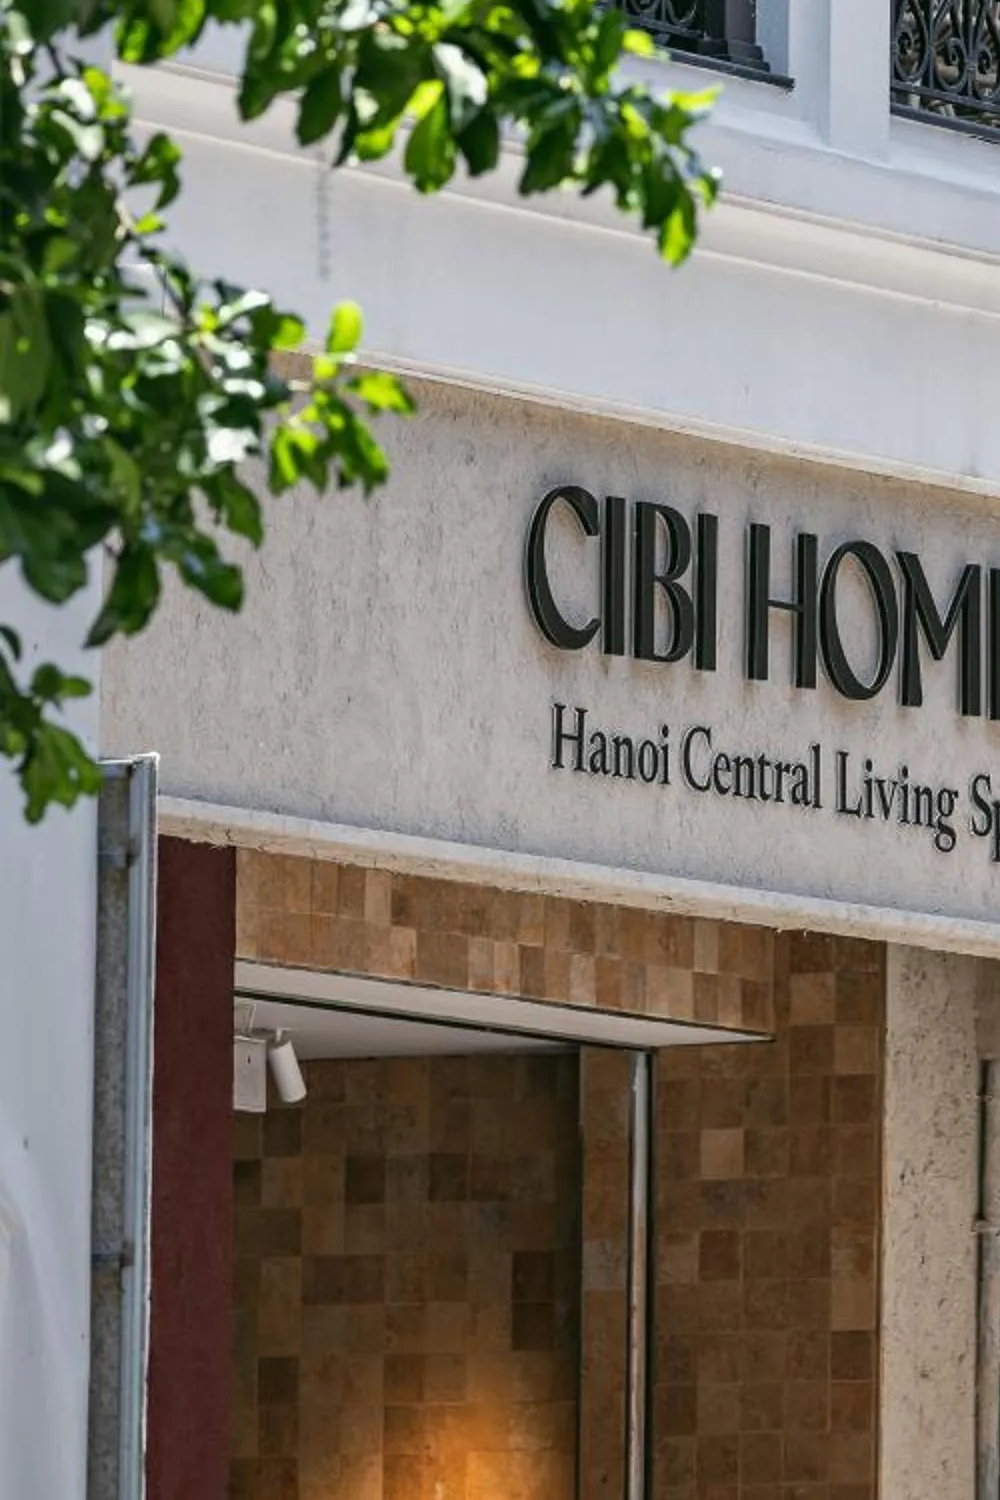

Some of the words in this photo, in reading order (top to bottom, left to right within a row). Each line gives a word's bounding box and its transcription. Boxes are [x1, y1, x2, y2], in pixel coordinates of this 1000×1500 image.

[522, 484, 720, 672] CIBI
[551, 702, 671, 786] Hanoi
[682, 725, 824, 811] Central
[835, 750, 960, 854] Living
